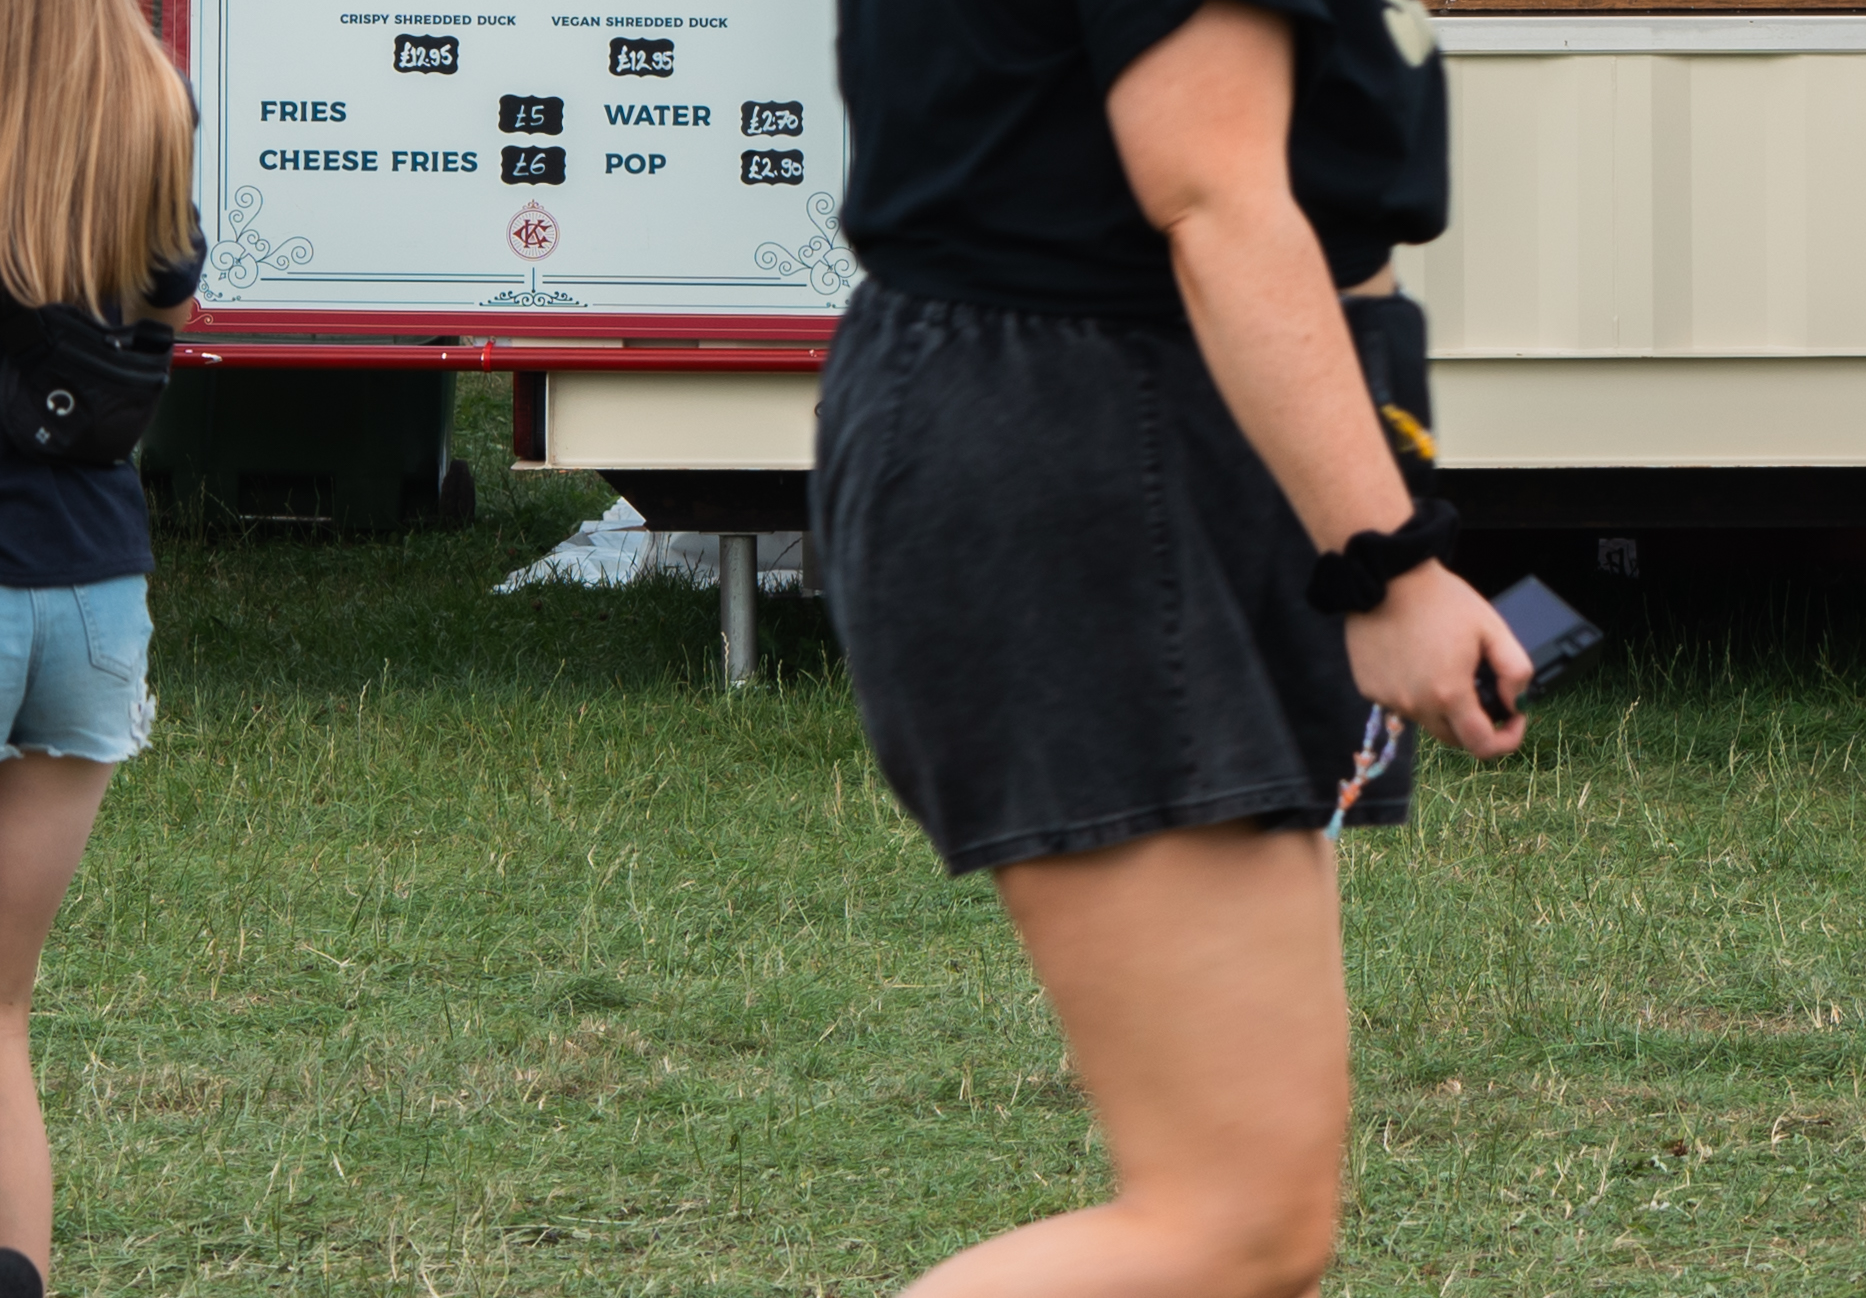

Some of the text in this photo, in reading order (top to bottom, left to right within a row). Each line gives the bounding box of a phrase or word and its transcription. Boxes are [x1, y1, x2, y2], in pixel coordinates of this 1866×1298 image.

[261, 101, 544, 127] FRIES £5
[604, 105, 710, 126] WATER
[259, 150, 545, 176] CHEESE FRIES £6
[606, 154, 666, 174] POP
